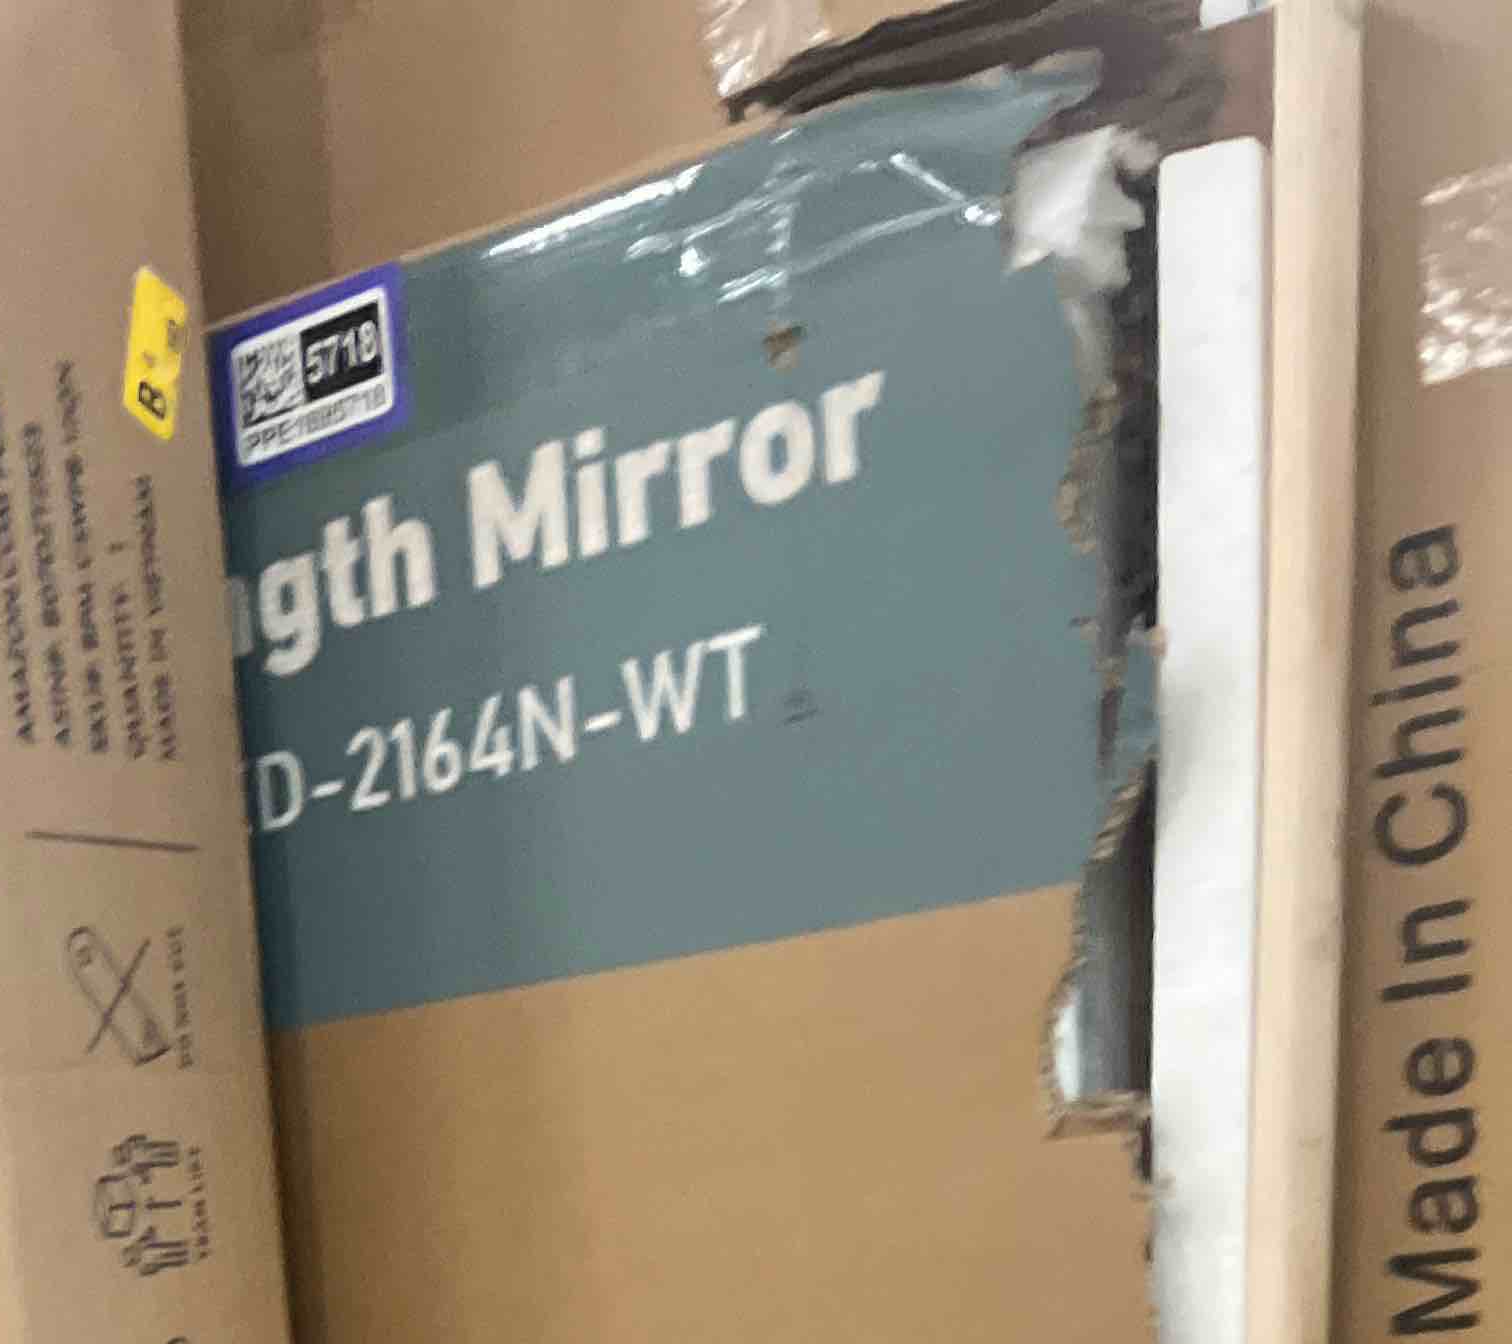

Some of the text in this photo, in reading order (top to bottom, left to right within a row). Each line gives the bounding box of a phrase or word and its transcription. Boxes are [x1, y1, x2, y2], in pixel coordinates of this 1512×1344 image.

[304, 318, 379, 386] 5718
[465, 369, 886, 592] Mirror
[247, 623, 767, 834] D-2164N-WT
[1367, 522, 1484, 1338] Made In China
